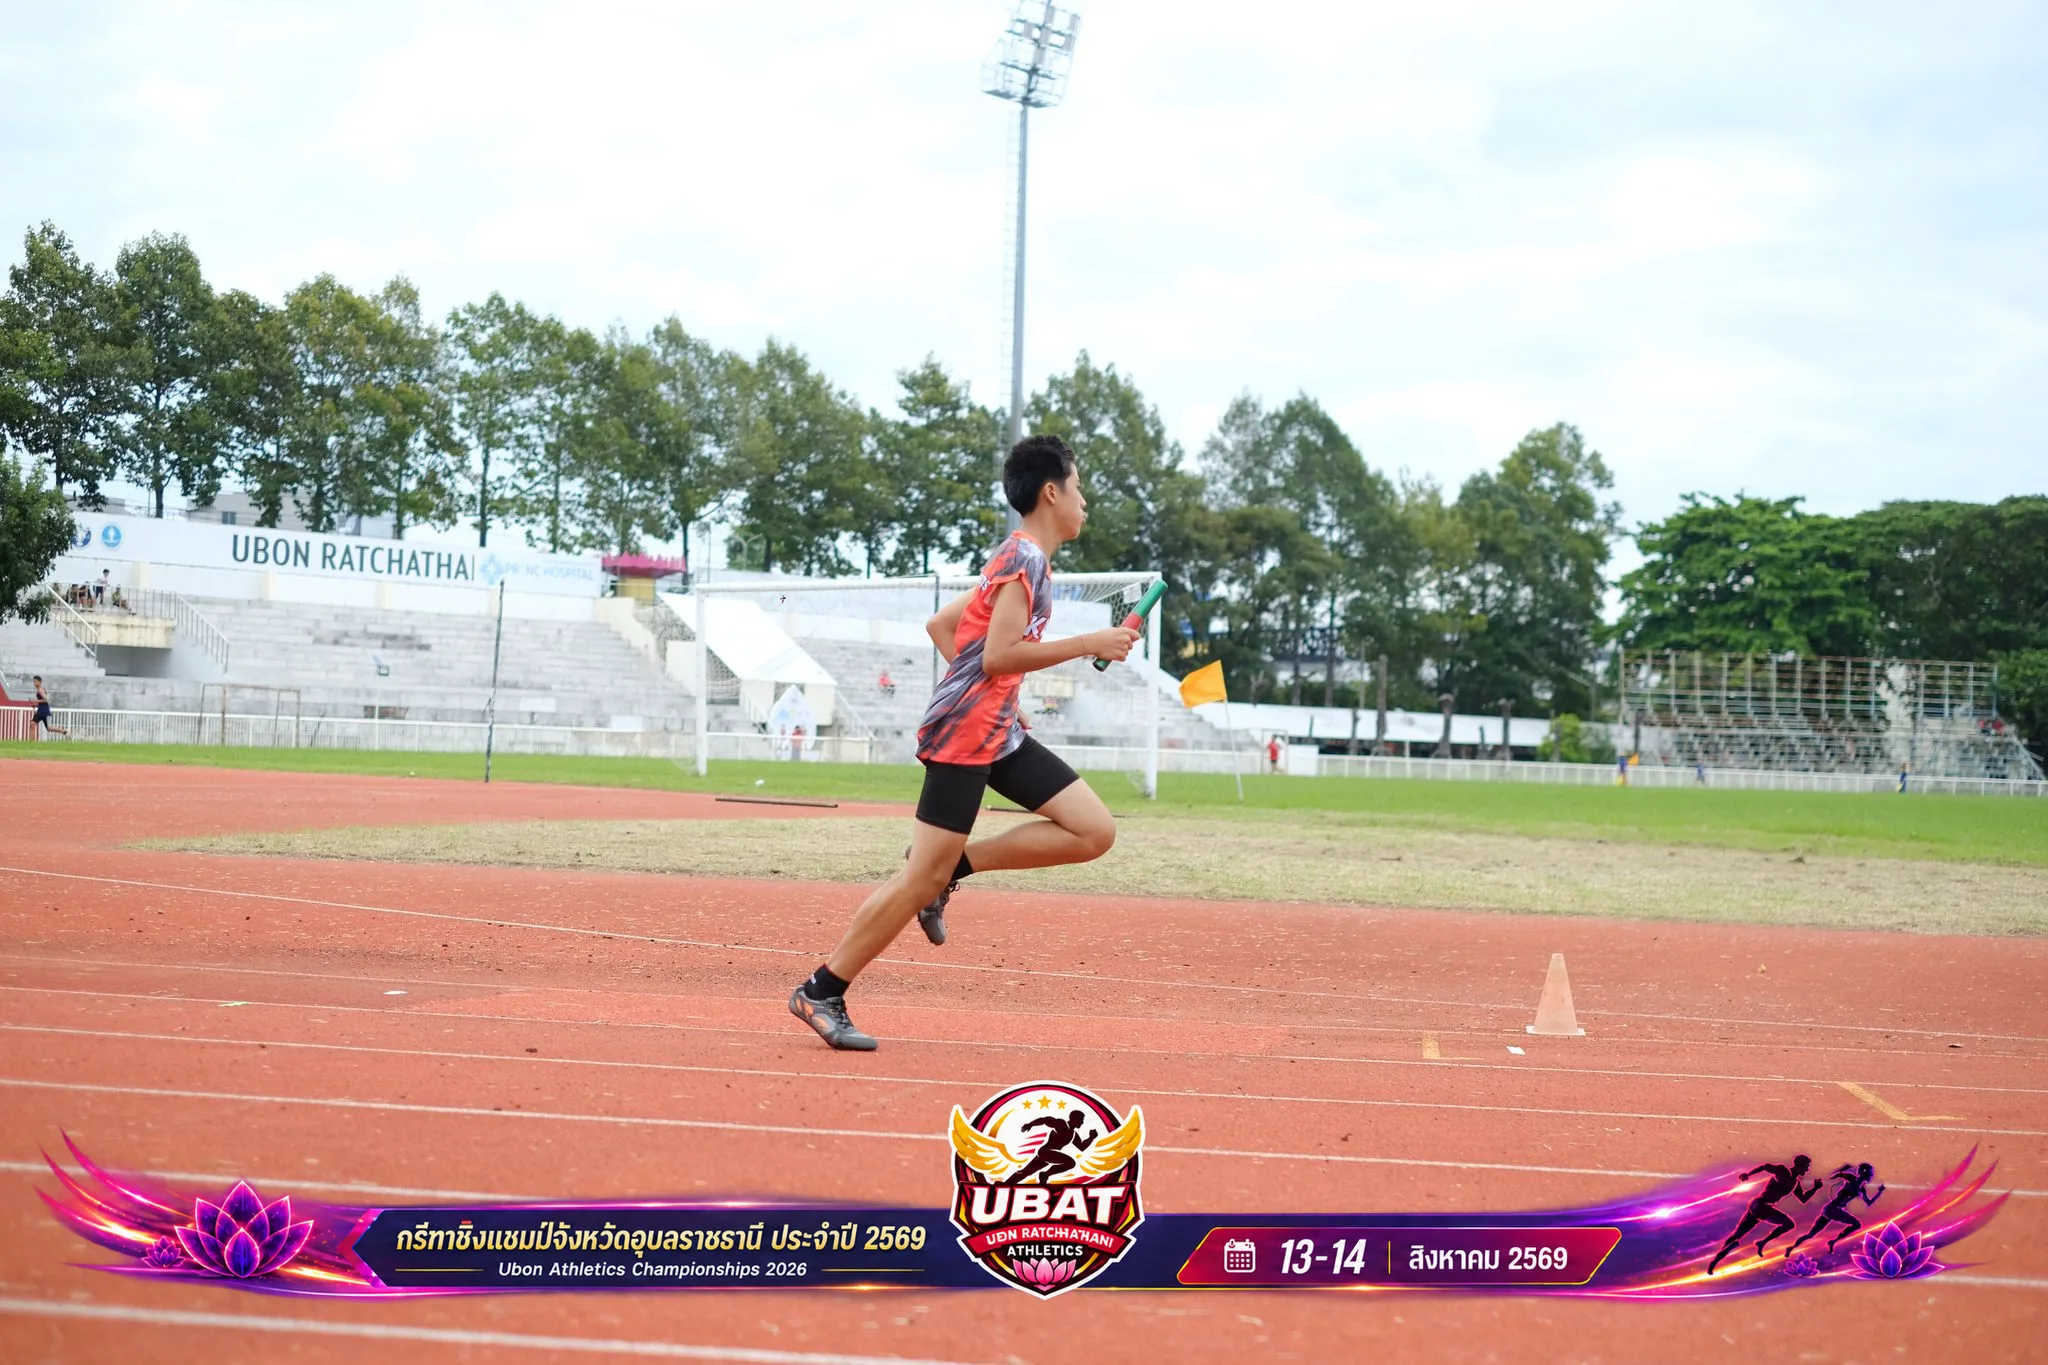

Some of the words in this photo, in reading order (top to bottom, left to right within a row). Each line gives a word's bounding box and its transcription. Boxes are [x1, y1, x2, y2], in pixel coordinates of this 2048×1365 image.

[231, 534, 311, 568] UBON
[321, 542, 475, 584] RATCHATHA
[543, 565, 595, 581] HOSPITAL
